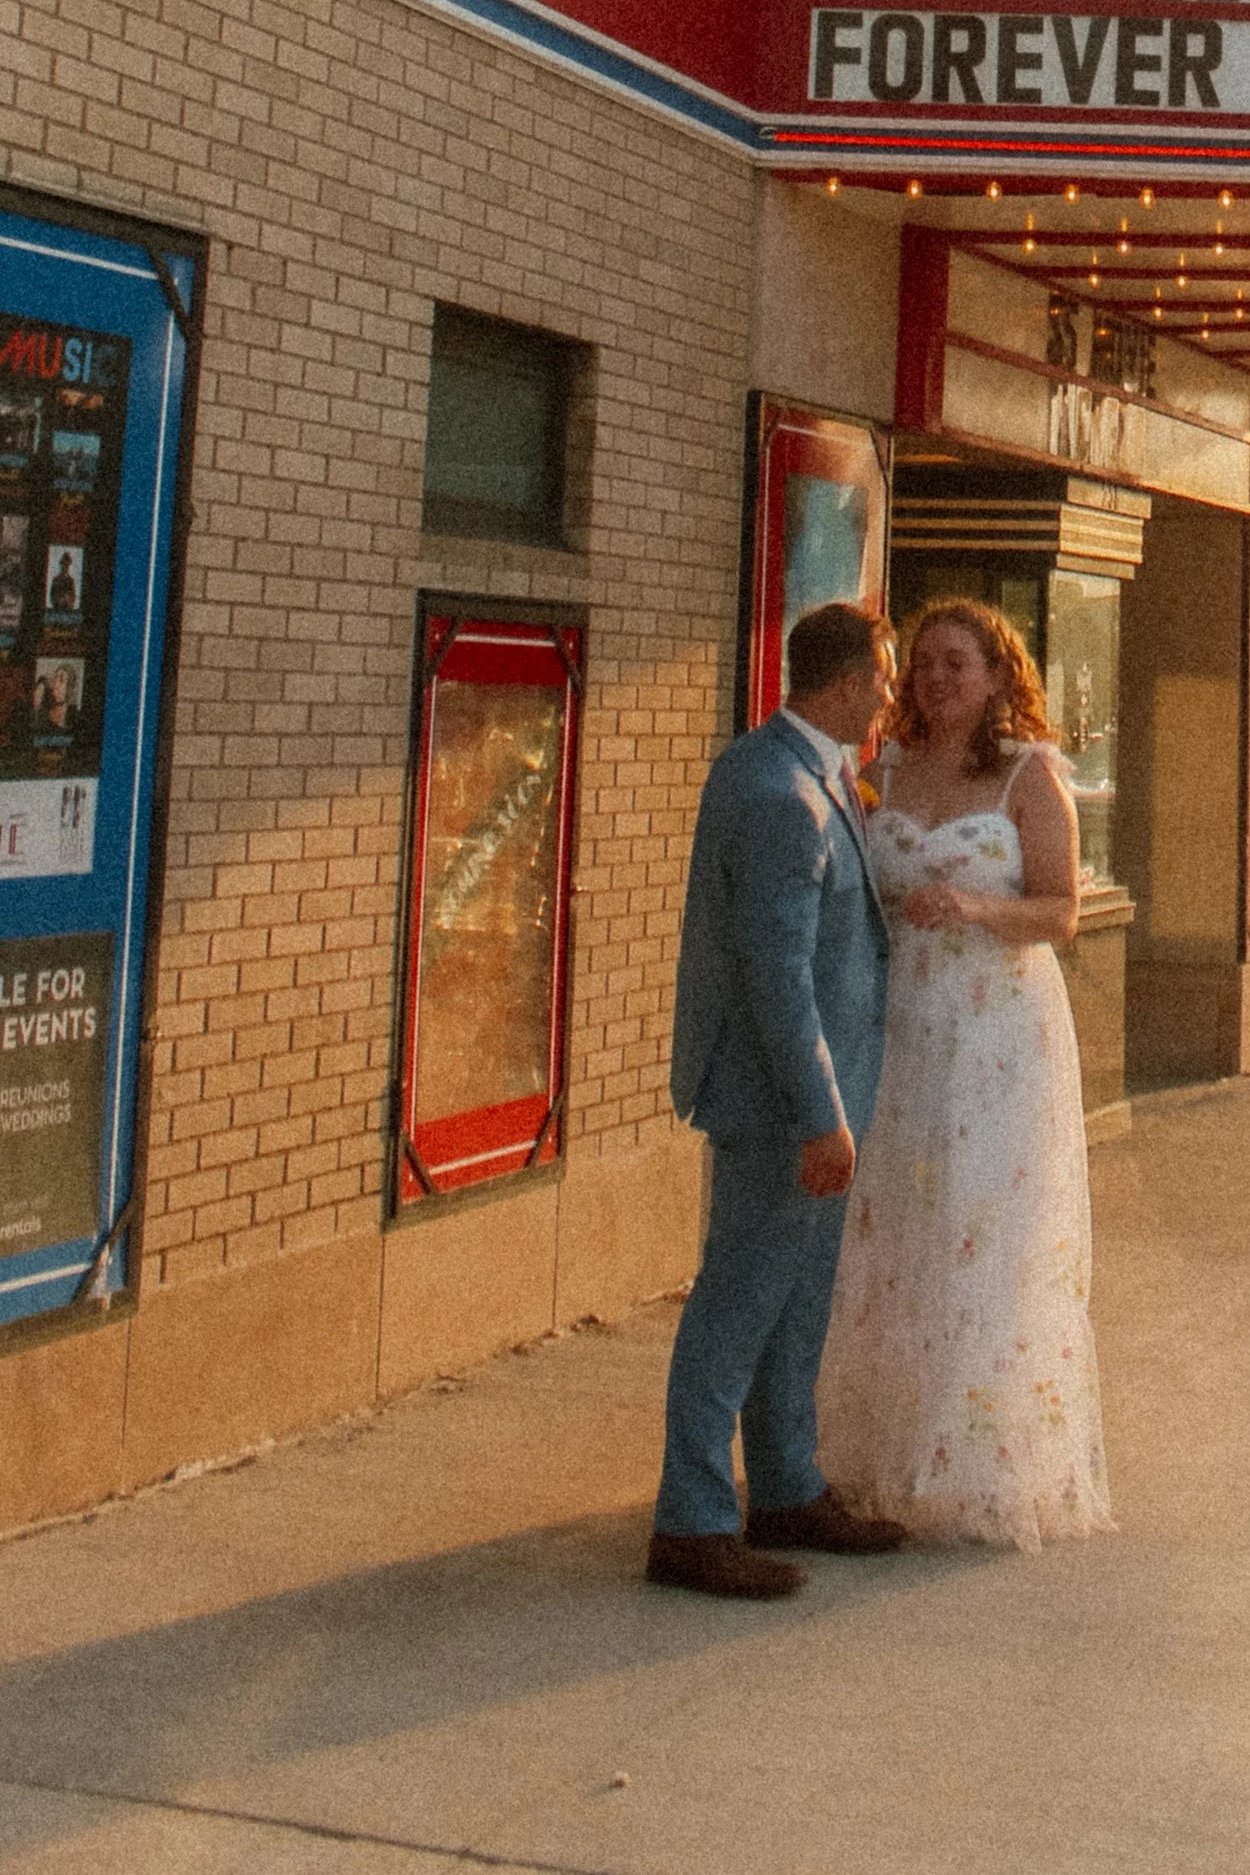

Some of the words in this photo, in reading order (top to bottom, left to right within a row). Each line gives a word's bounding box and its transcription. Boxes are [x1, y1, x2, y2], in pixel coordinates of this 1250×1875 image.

[814, 11, 1223, 109] FOREVER
[36, 966, 85, 1004] FOR
[3, 1006, 96, 1049] EVENTS
[0, 1078, 70, 1109] REUNIONS
[0, 1102, 72, 1132] WEDDINGS
